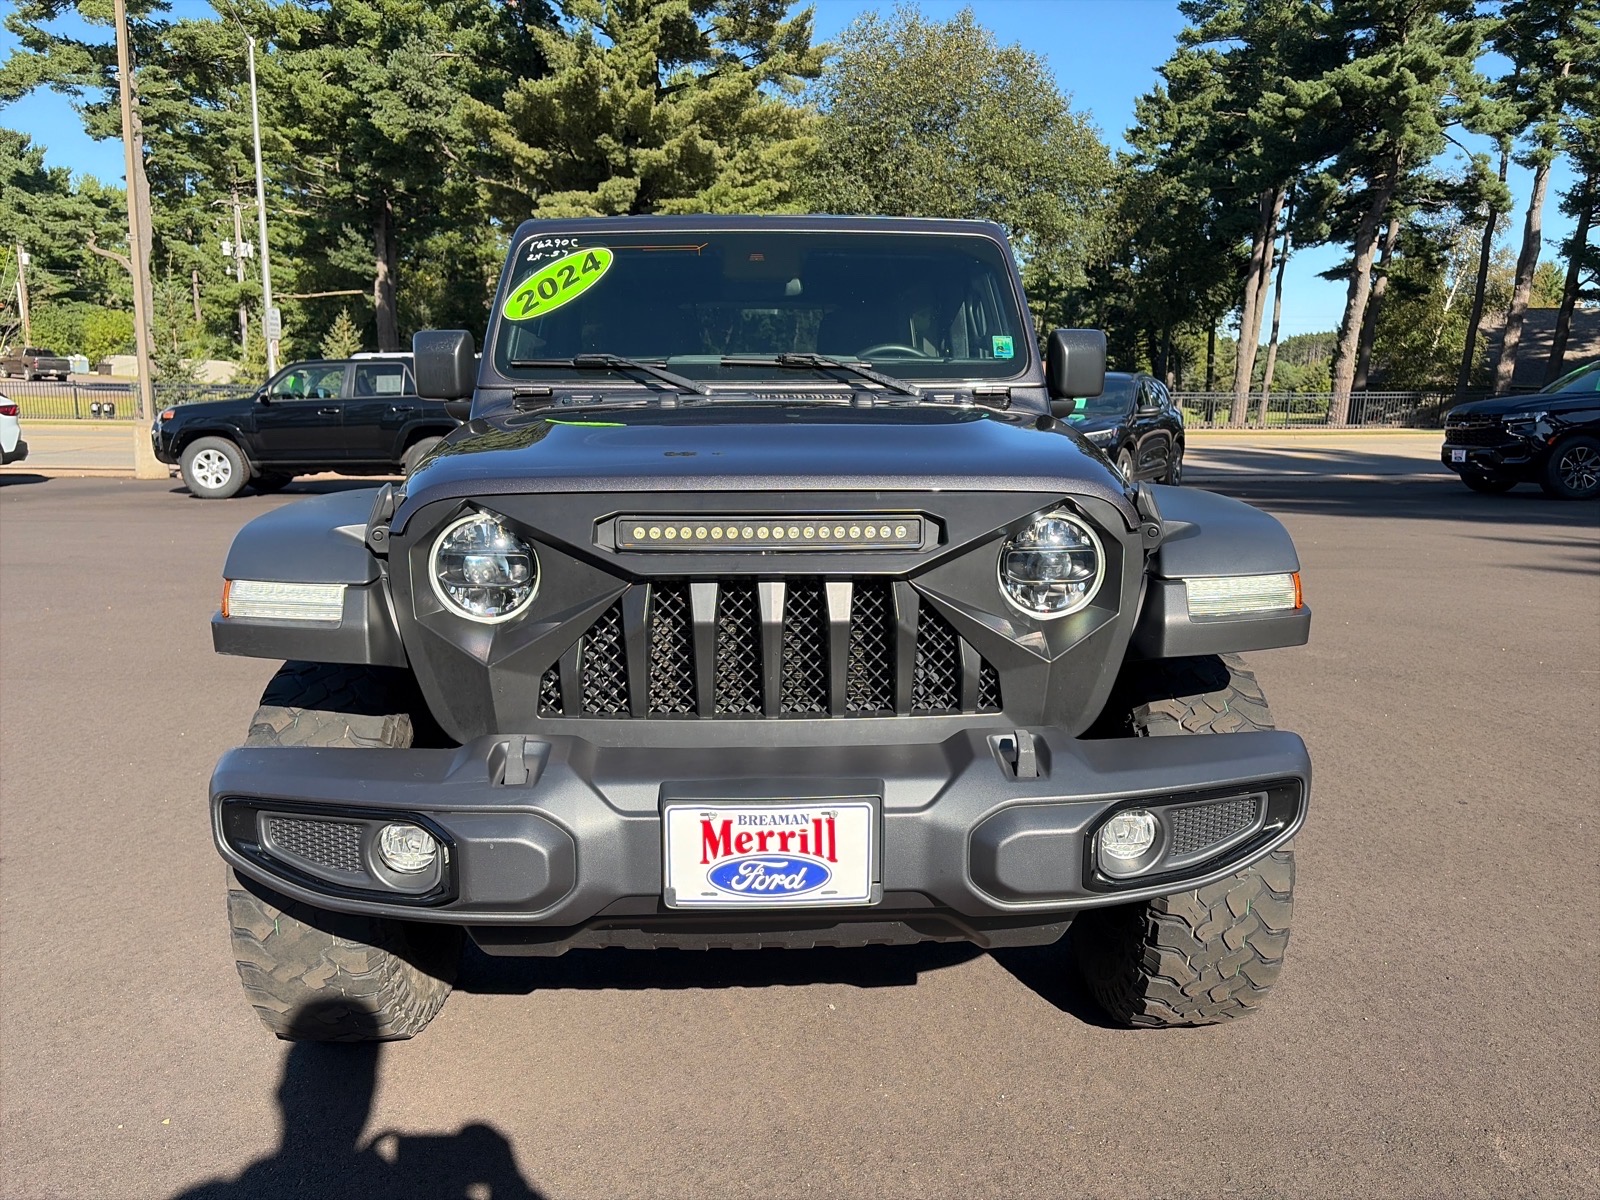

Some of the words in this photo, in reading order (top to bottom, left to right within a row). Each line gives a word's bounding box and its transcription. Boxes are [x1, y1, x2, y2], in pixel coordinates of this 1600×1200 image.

[516, 252, 602, 315] 2024
[737, 813, 810, 826] BREAMAN
[700, 818, 838, 864] Merrill
[730, 860, 807, 890] Ford
